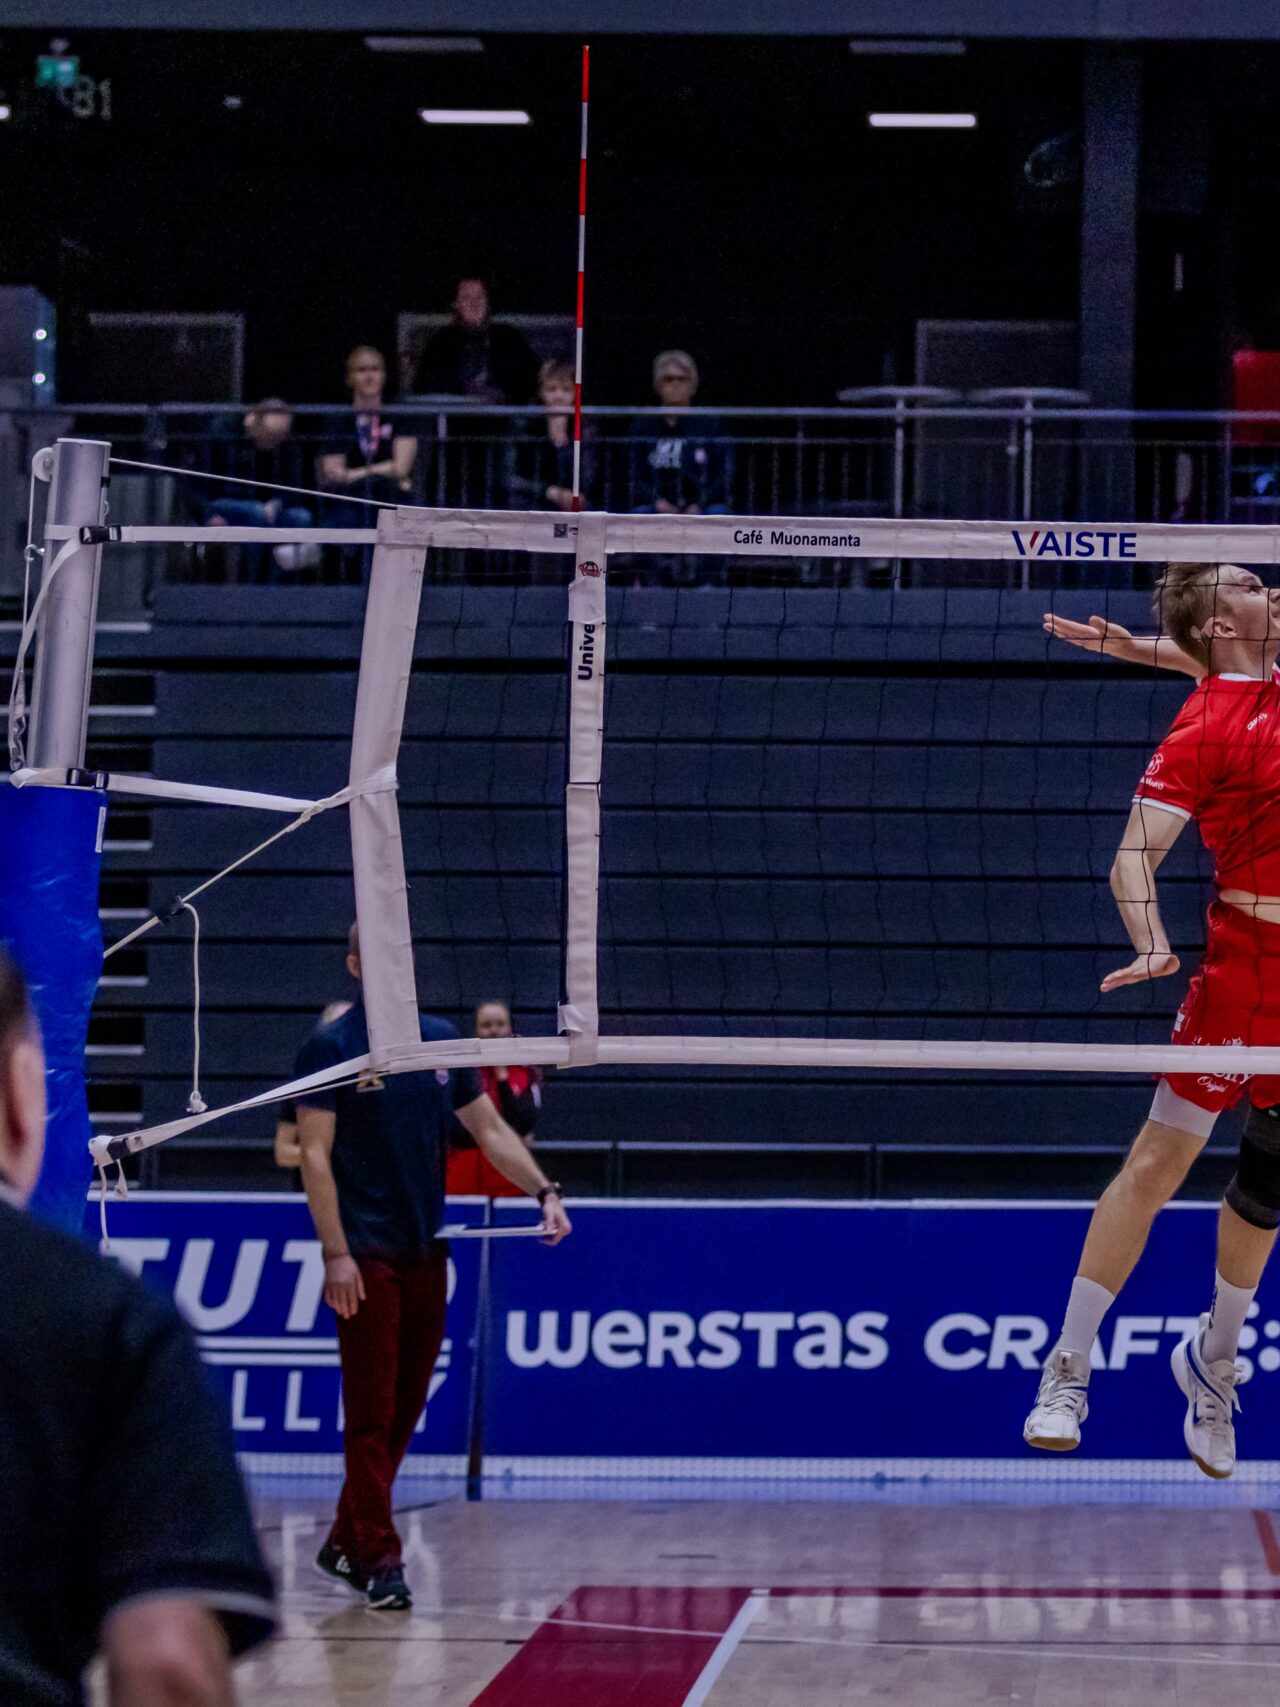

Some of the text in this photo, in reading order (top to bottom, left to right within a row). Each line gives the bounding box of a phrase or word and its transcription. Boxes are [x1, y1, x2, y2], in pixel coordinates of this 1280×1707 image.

[733, 530, 861, 547] Café Muonamanta
[1012, 530, 1137, 558] VAISTE
